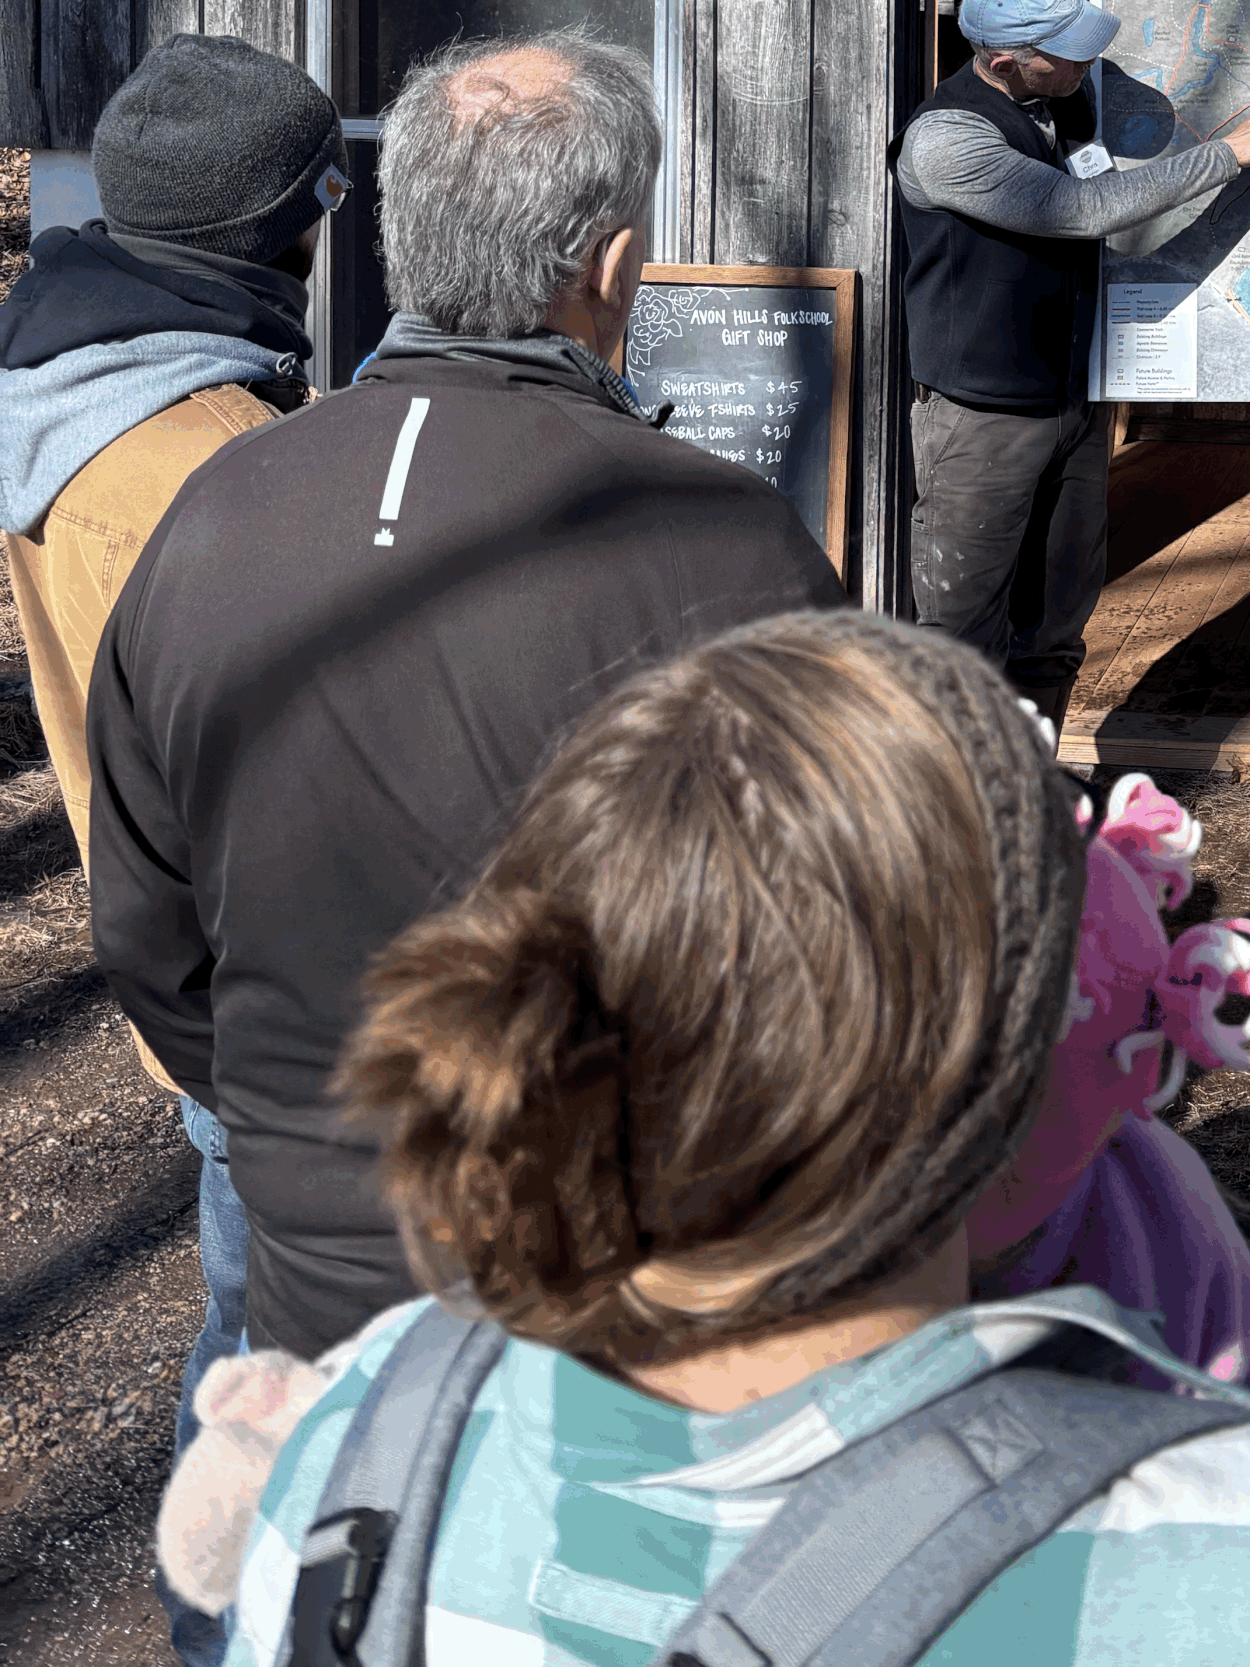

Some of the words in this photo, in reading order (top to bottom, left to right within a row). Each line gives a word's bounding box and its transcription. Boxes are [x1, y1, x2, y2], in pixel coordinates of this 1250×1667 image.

[1123, 287, 1143, 296] Legend
[690, 309, 727, 326] AVON
[733, 308, 769, 327] HILLS
[721, 328, 751, 347] GIFT
[756, 328, 788, 347] SHOP
[660, 379, 746, 398] SWEATSHIRTS
[765, 380, 803, 394] $45
[765, 401, 800, 417] $25
[708, 425, 736, 440] CAPS
[761, 423, 791, 441] $20
[756, 447, 783, 465] $20
